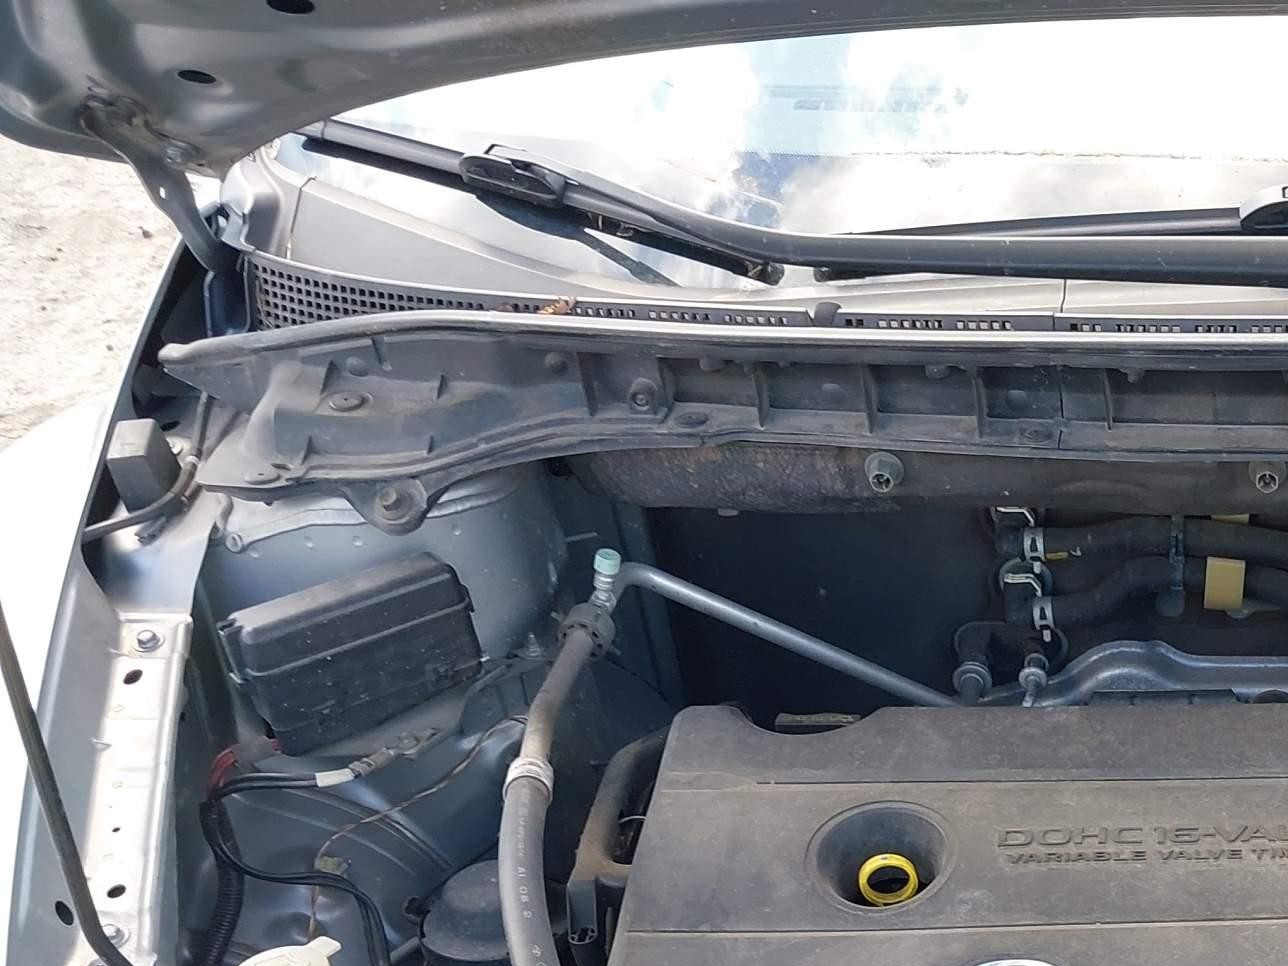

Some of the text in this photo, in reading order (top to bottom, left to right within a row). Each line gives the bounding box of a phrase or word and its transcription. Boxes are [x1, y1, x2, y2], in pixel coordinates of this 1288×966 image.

[997, 827, 1144, 849] DOHC
[1006, 849, 1148, 865] VARIABLE
[1158, 847, 1244, 862] VALVE
